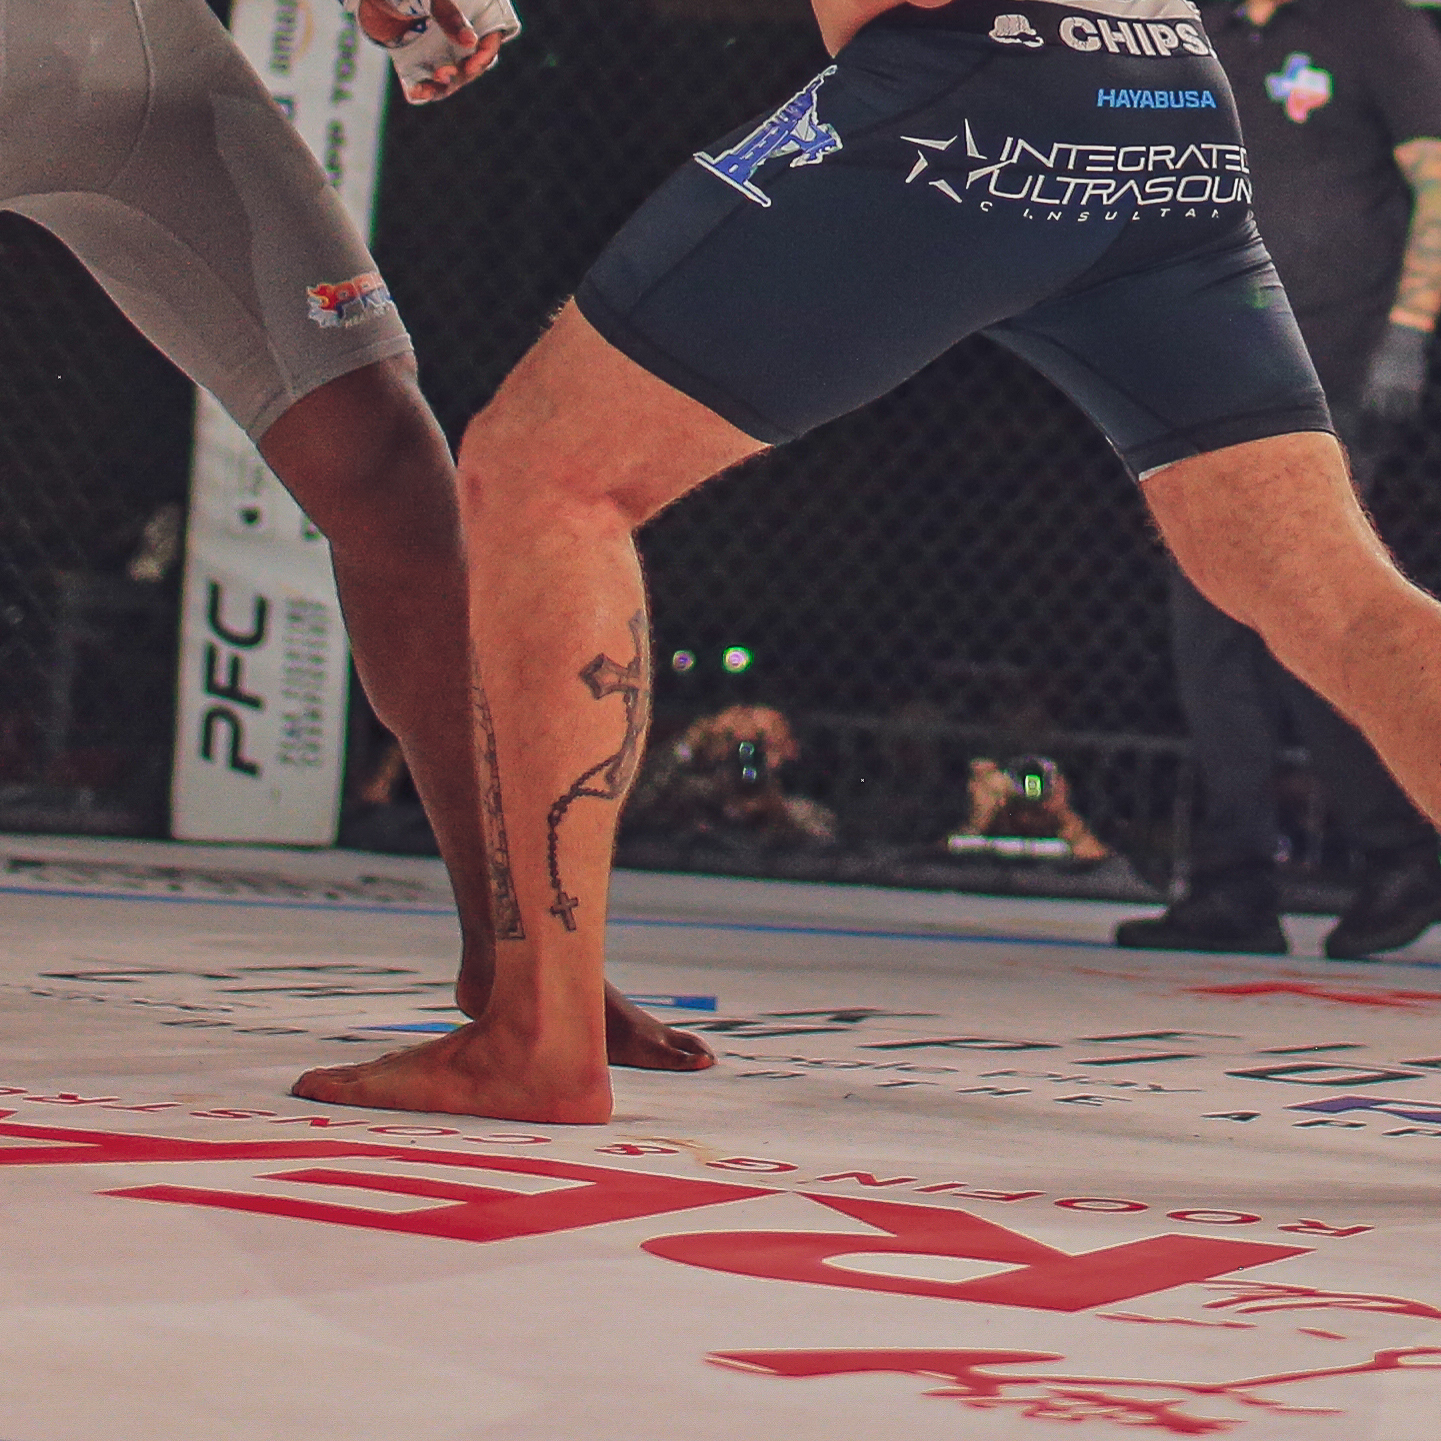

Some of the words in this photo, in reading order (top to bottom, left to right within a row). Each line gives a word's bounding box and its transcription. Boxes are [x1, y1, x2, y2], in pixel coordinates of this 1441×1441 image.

[1059, 16, 1211, 57] CHIPS
[1096, 88, 1218, 110] HAYABUSA
[198, 579, 268, 780] PFC
[594, 1142, 681, 1159] &
[704, 1156, 1374, 1239] ROOFING
